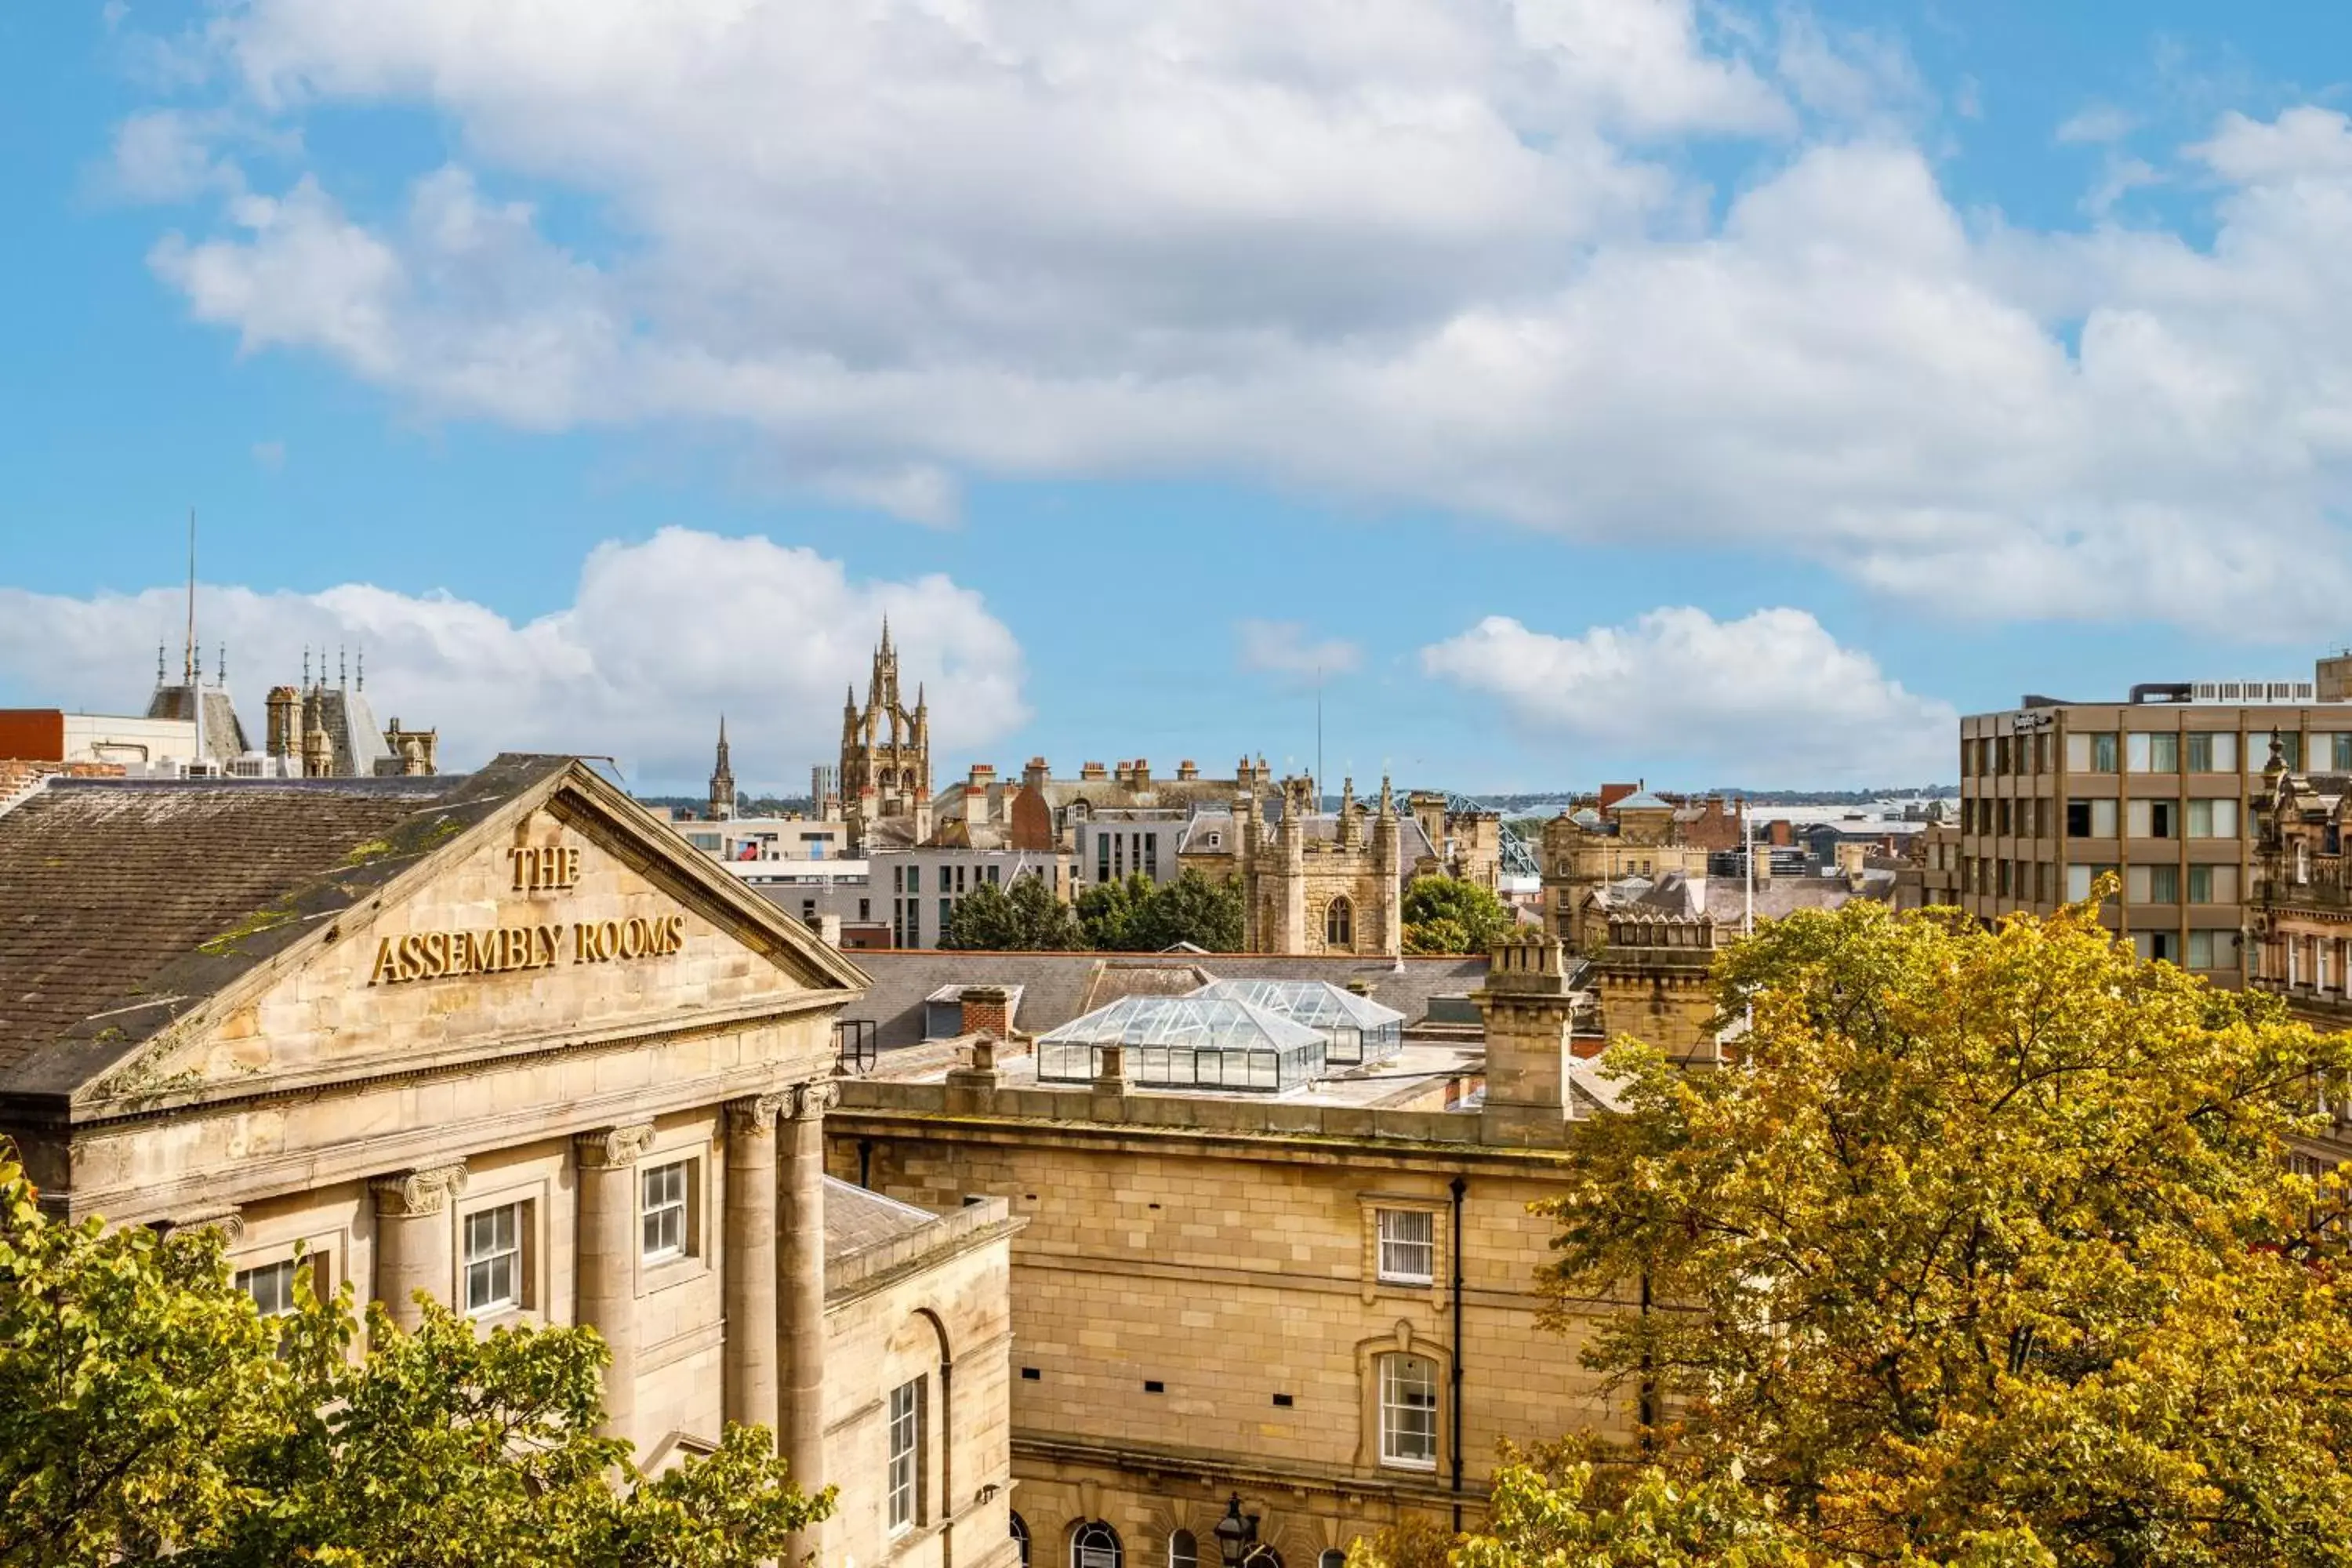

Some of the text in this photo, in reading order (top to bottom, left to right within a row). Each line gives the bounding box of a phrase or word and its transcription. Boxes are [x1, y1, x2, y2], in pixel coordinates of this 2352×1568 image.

[508, 846, 580, 891] THE
[368, 914, 685, 986] ASSEMBLY ROOMS
